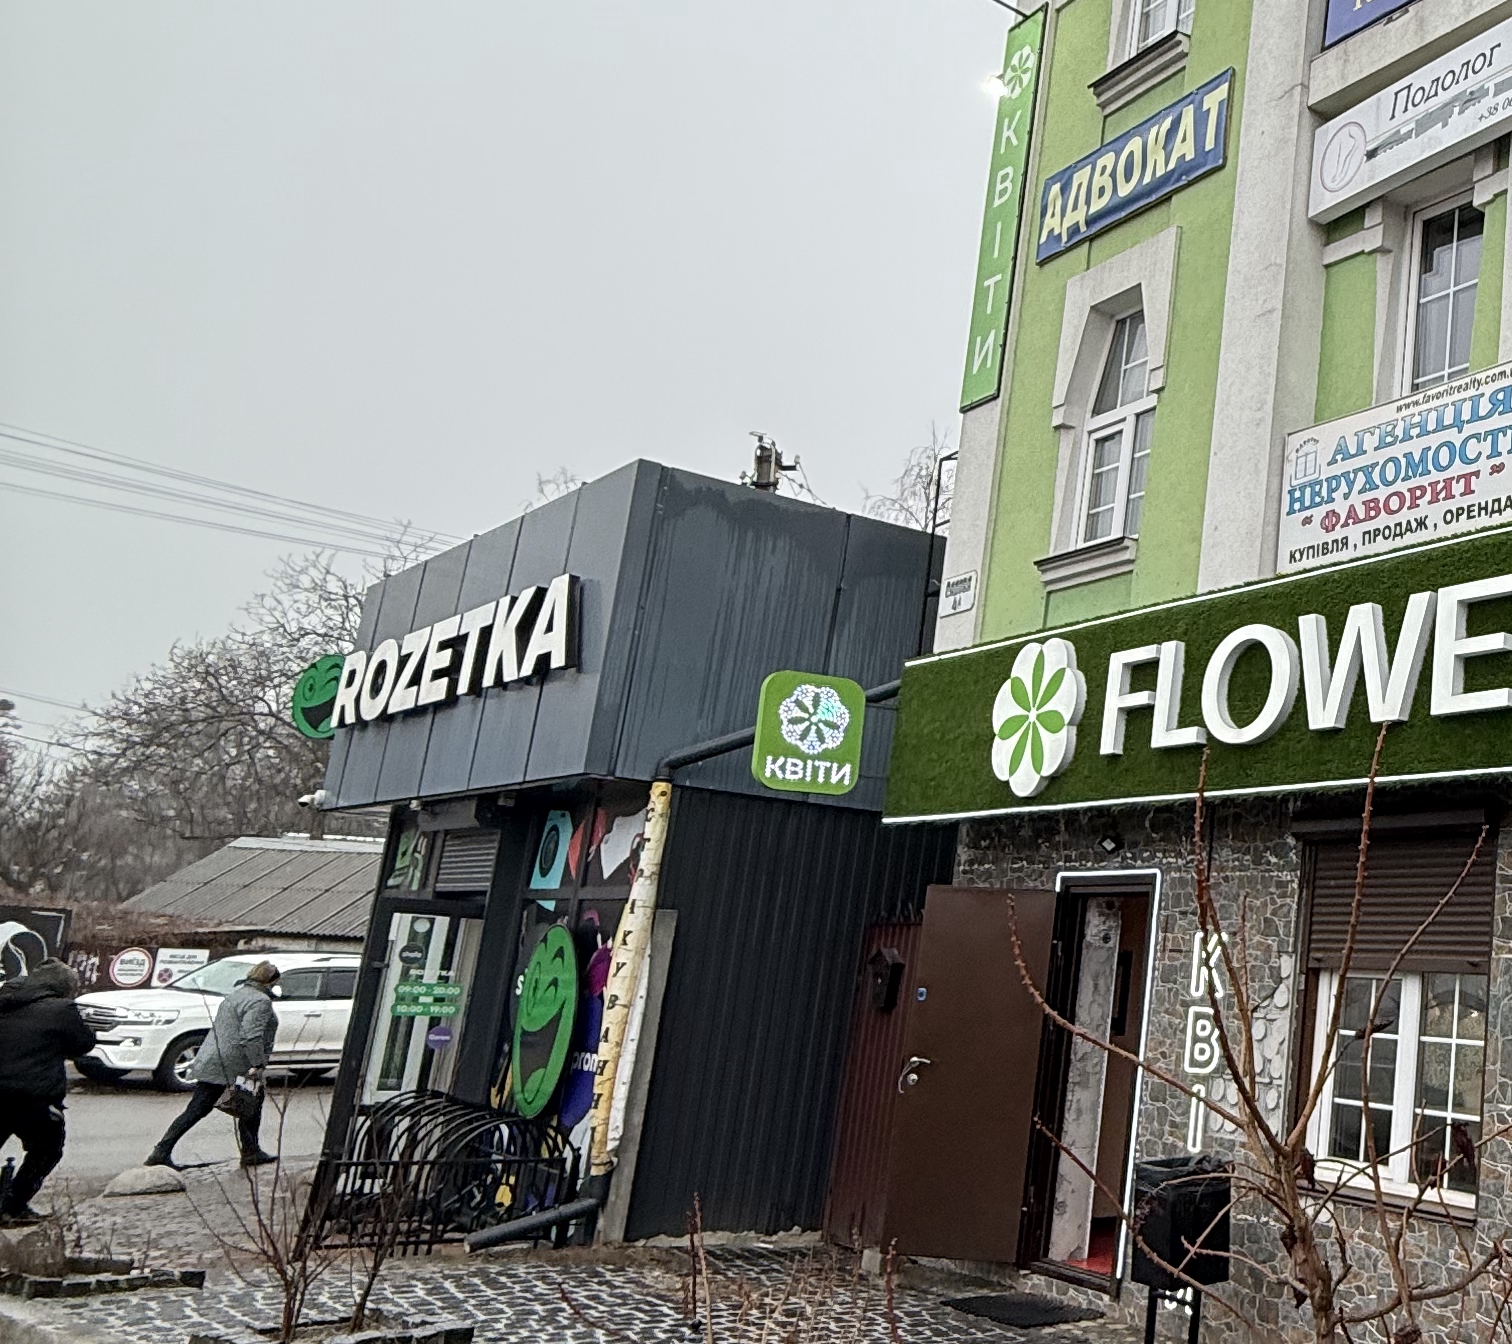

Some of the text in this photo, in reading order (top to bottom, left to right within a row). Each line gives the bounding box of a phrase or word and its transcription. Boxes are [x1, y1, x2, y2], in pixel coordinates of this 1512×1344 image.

[1389, 43, 1501, 121] Подолог
[972, 109, 1022, 375] КВІТИ
[1039, 82, 1228, 247] АДВОКАТ
[330, 573, 576, 729] ROZETKA
[765, 755, 851, 786] КВІТИ
